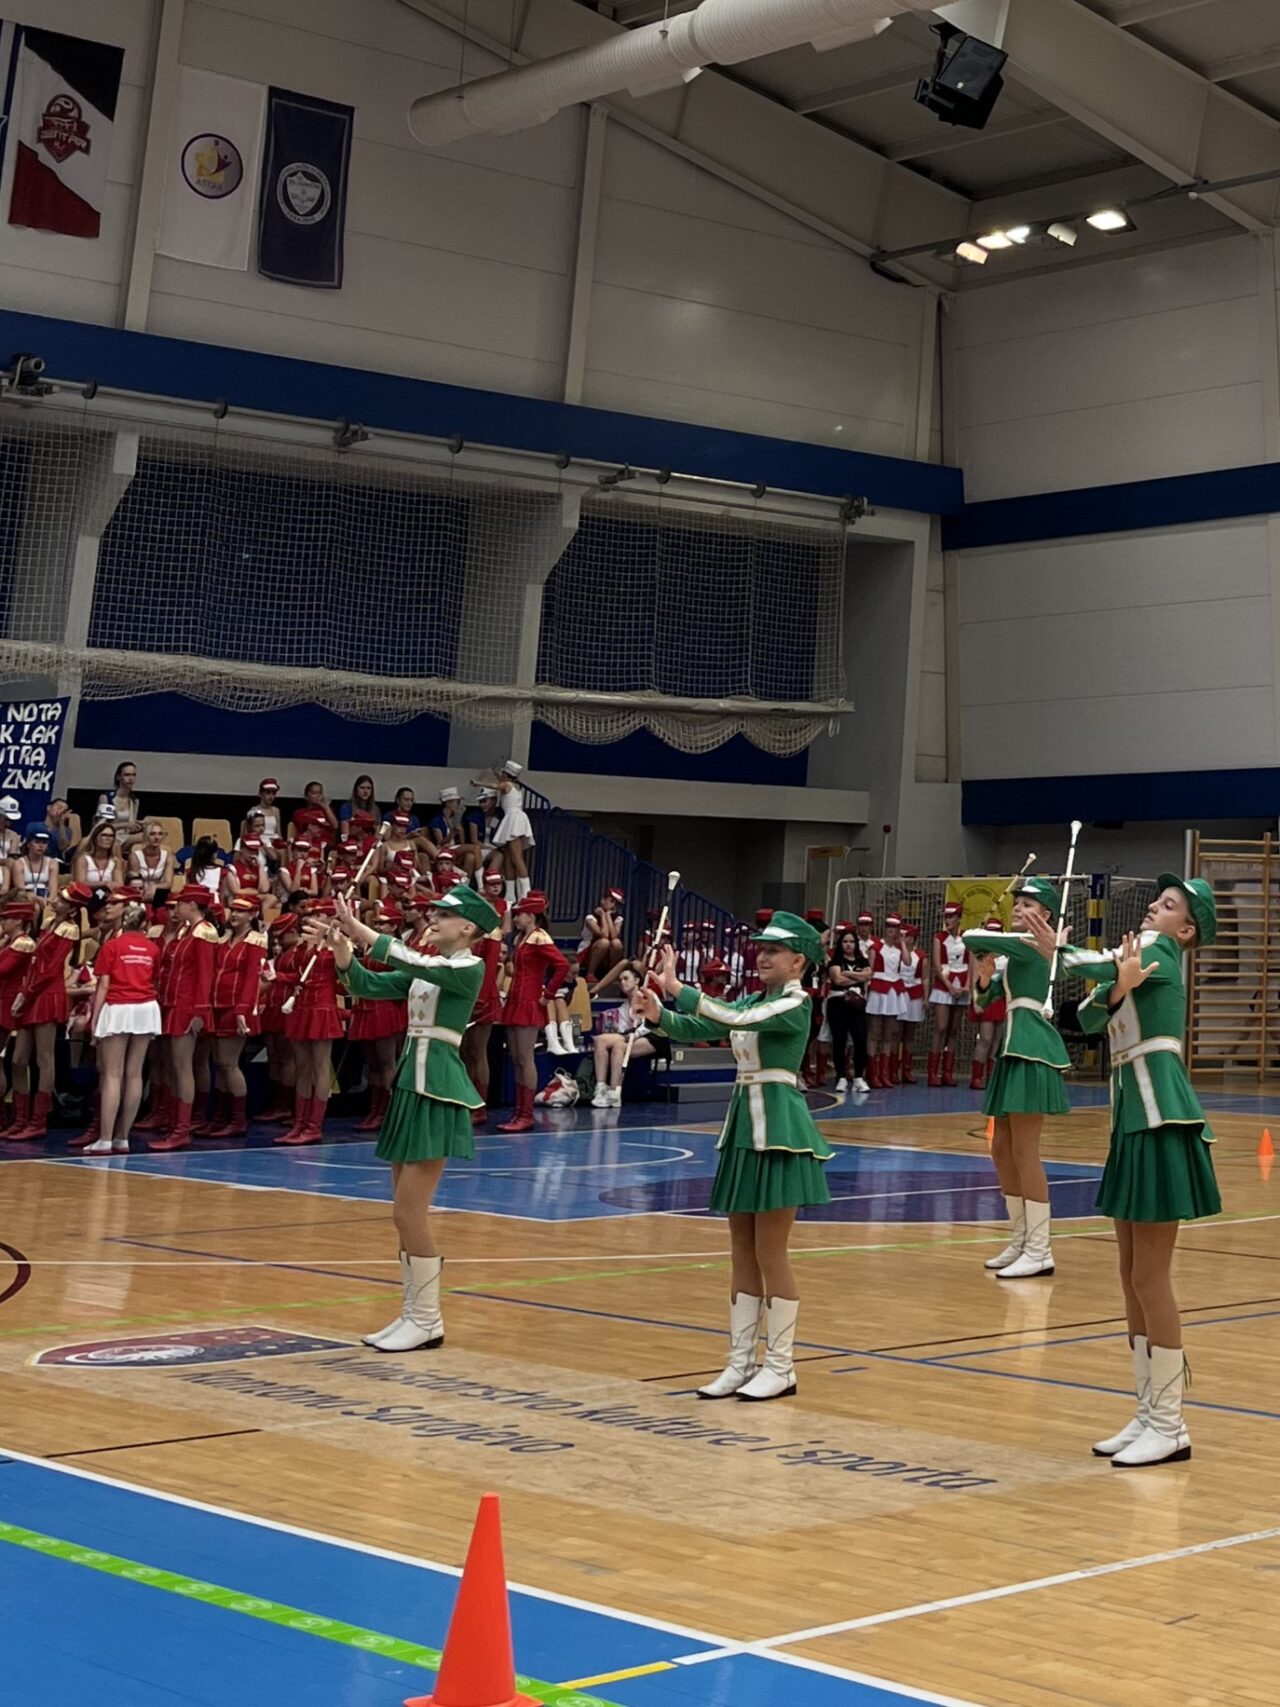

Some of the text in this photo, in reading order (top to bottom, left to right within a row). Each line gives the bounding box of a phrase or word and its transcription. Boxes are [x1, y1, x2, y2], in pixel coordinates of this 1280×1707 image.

[7, 702, 62, 723] NOTA
[20, 723, 59, 745] LAK
[2, 768, 54, 792] ZNAK
[292, 1356, 583, 1411] Ministarstvo
[562, 1404, 770, 1448] kulture
[776, 1445, 998, 1491] sporta
[340, 1404, 576, 1455] Sarajevo
